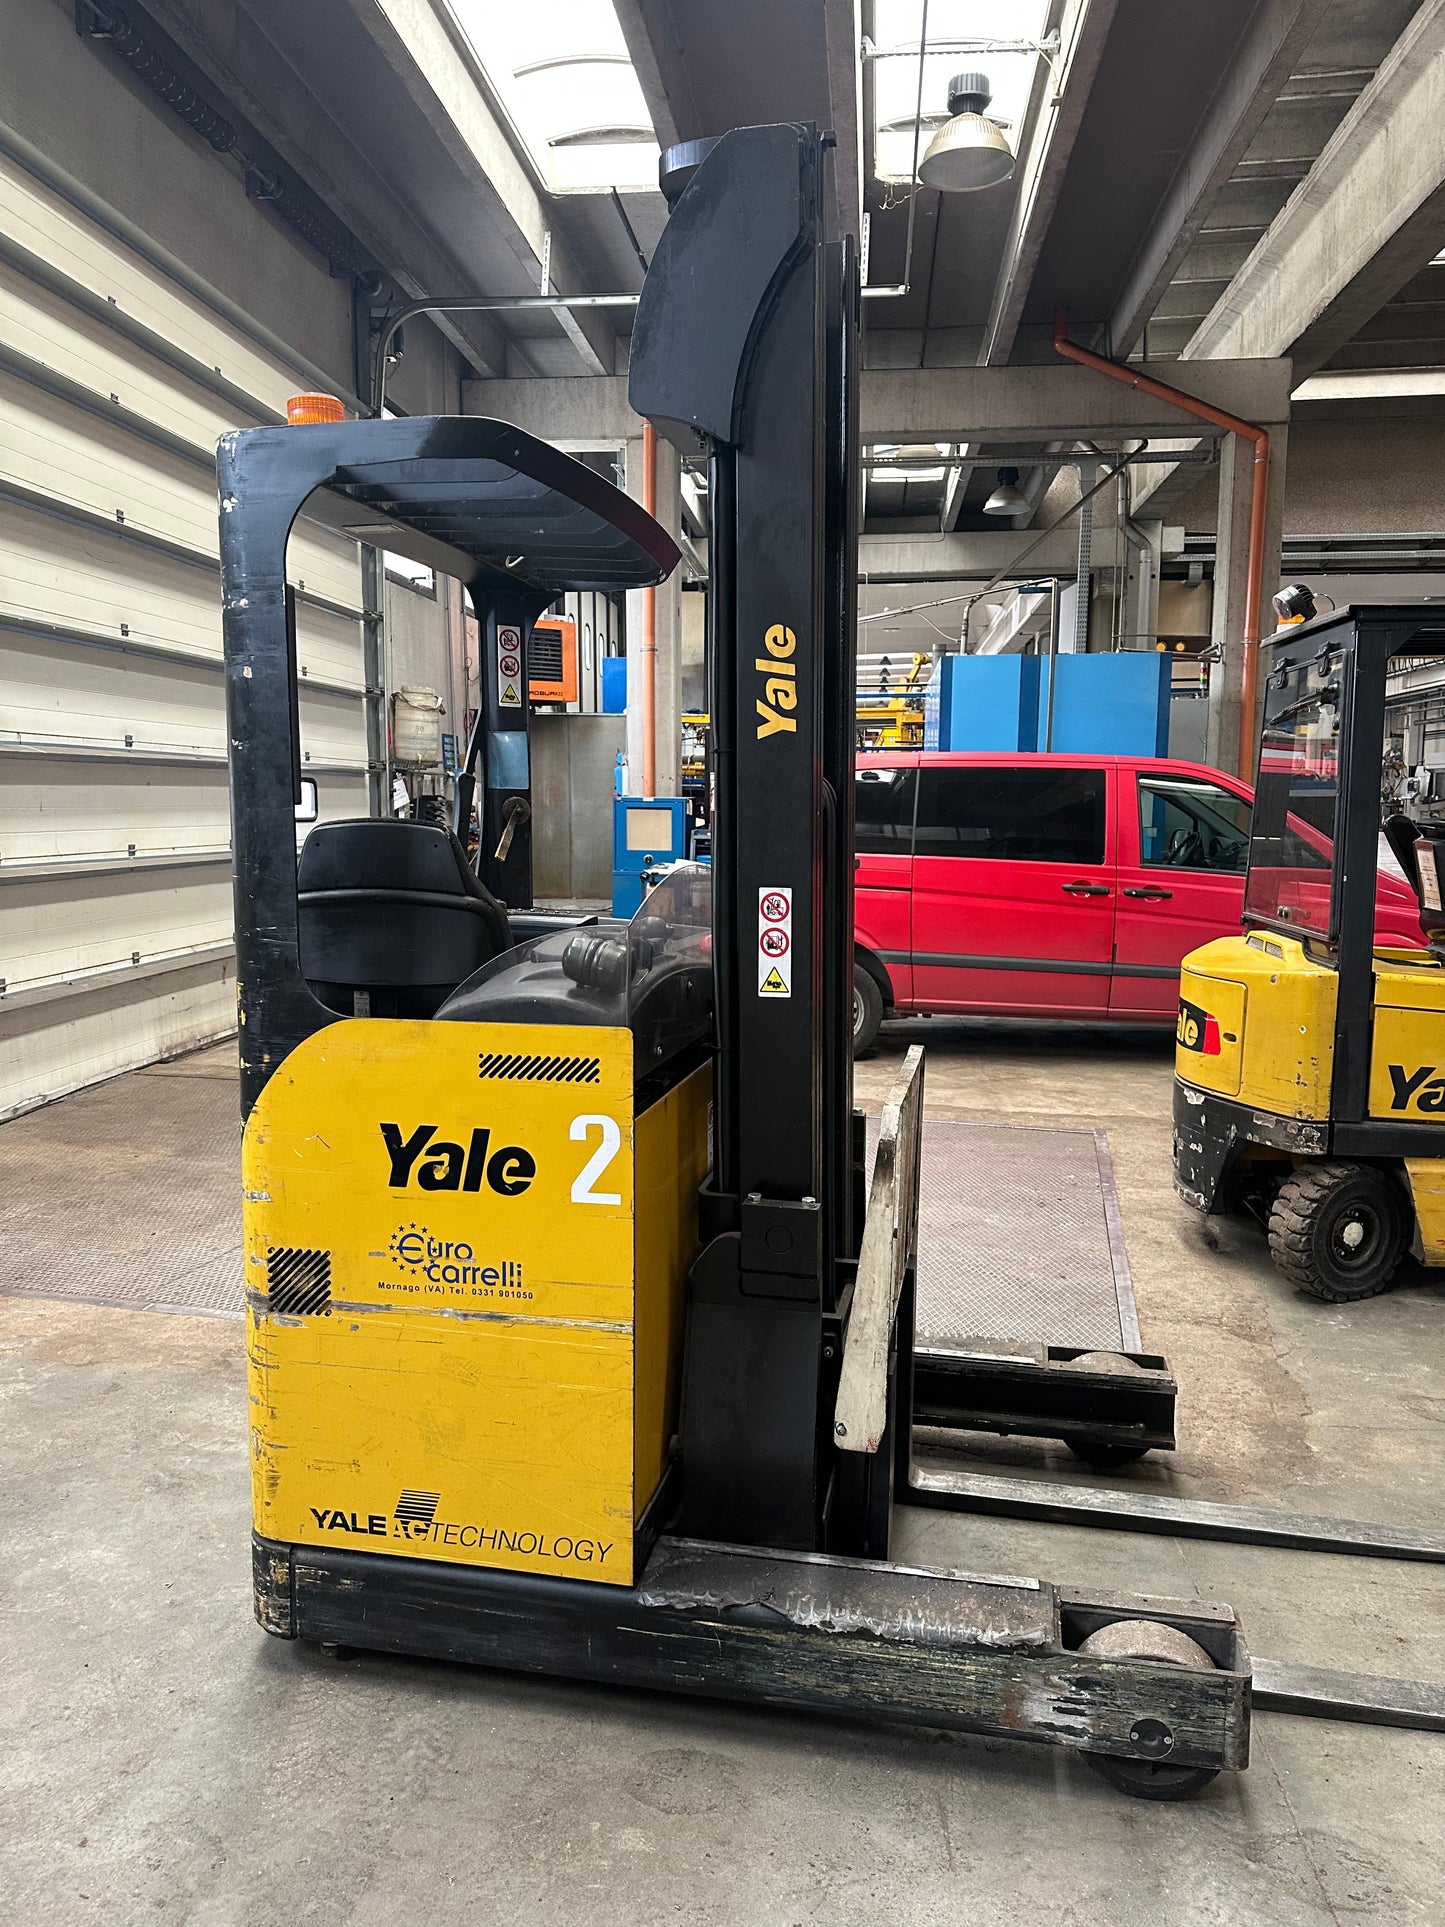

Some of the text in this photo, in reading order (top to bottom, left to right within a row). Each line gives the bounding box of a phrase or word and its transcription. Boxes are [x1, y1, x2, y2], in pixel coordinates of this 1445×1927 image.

[756, 624, 797, 740] Yale
[1177, 1006, 1199, 1046] ale
[379, 1123, 536, 1196] Yale
[569, 1114, 622, 1206] 2
[378, 1281, 534, 1299] Mornago (VA) Tel. 0331 901050
[426, 1261, 522, 1288] carrelli
[309, 1507, 387, 1536] YALE
[431, 1521, 614, 1563] TECHNOLOGY
